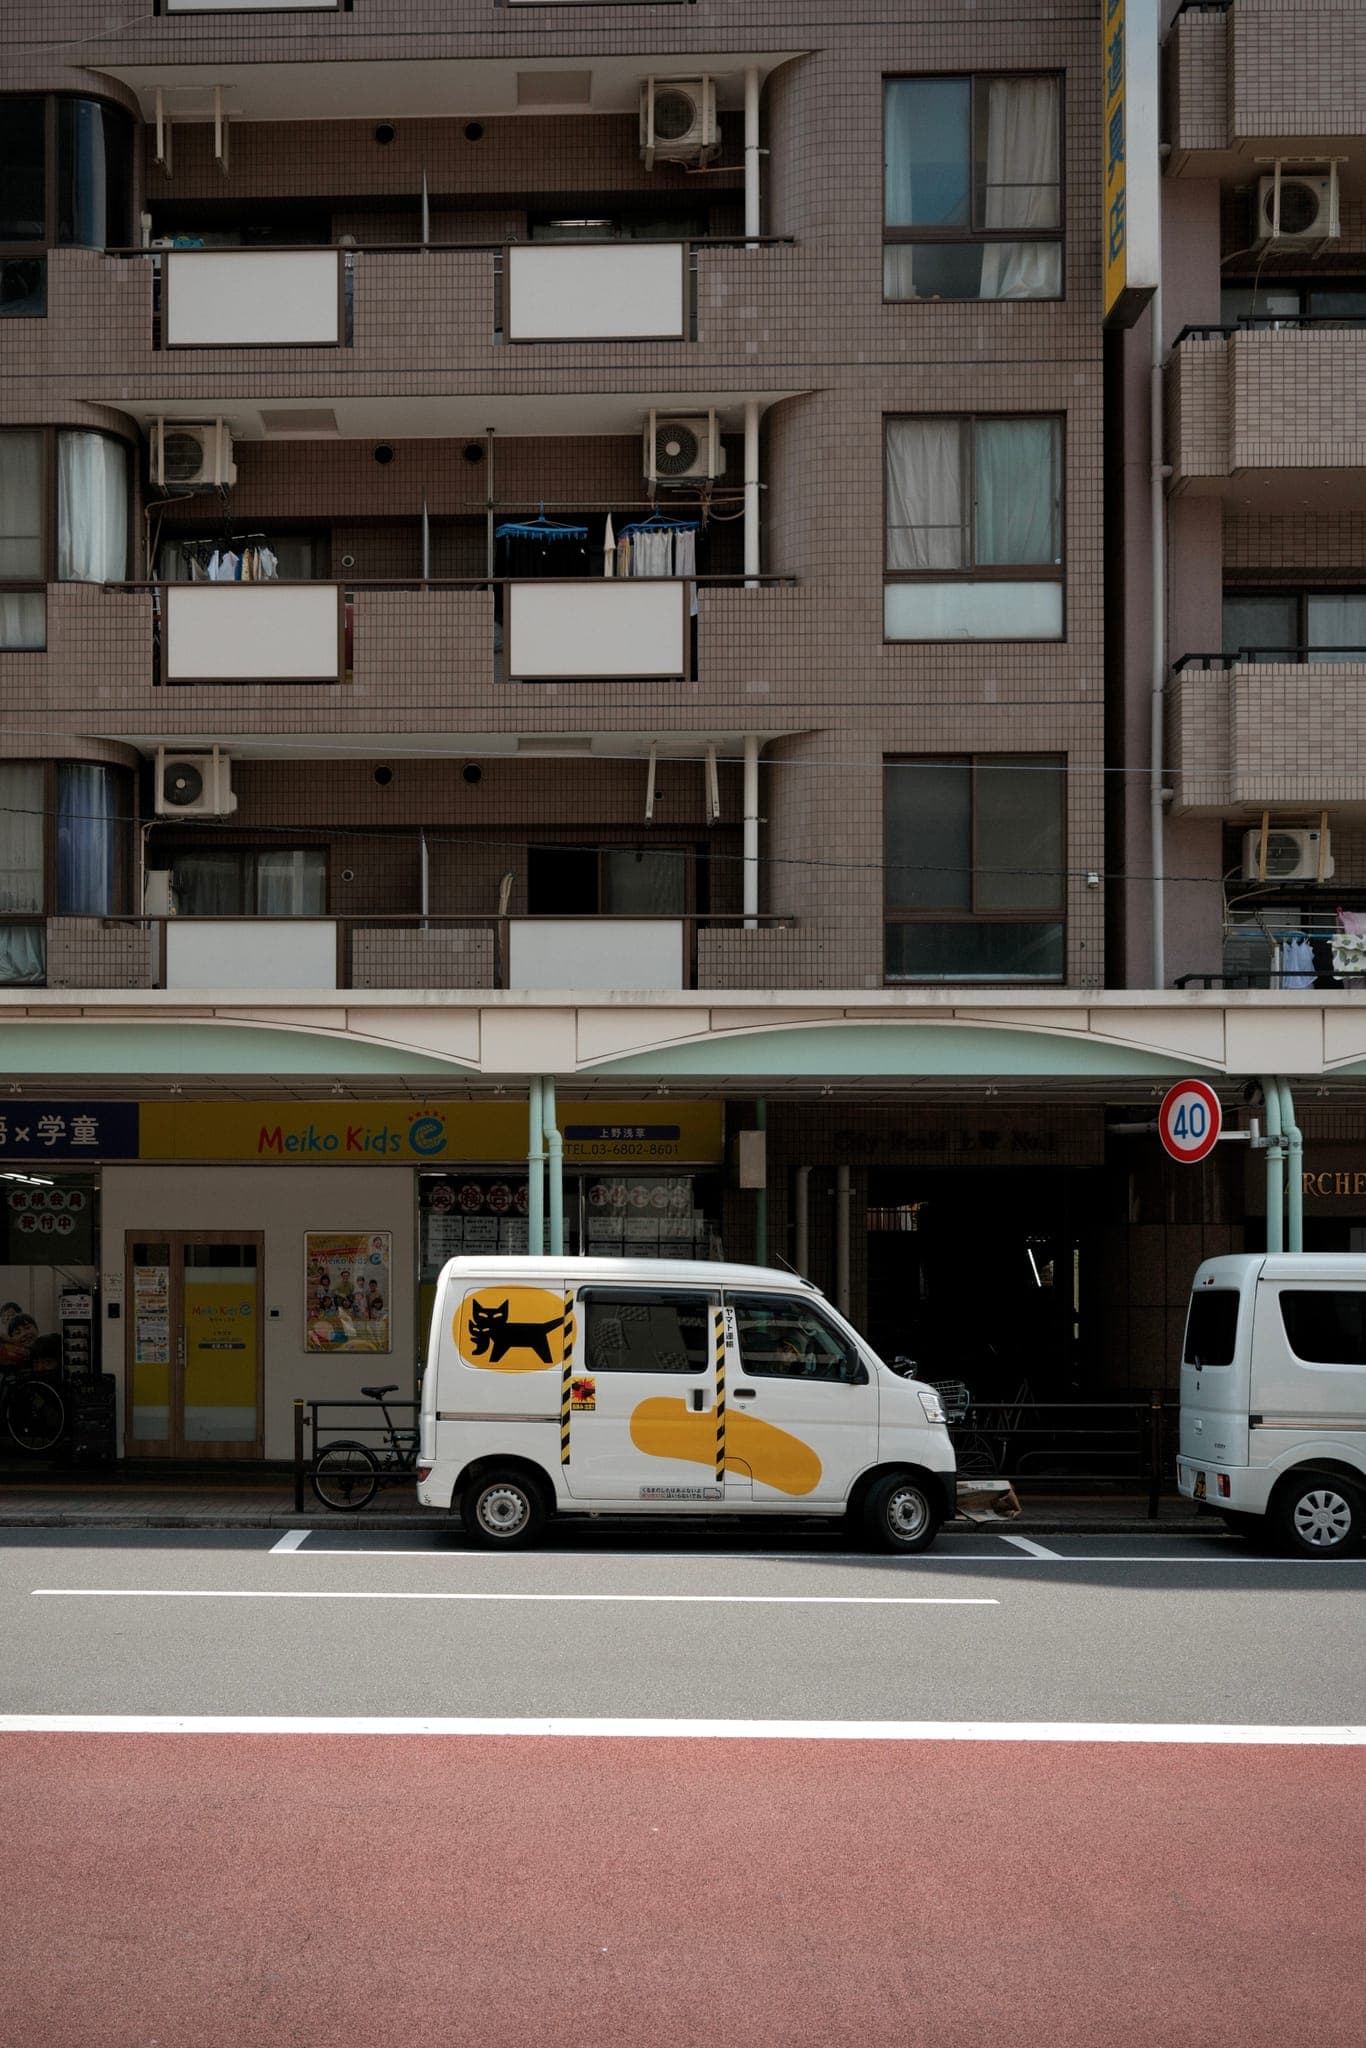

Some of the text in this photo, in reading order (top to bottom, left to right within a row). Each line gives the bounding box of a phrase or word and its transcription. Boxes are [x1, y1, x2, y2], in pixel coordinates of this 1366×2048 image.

[1107, 0, 1125, 269] 道具店
[599, 1127, 647, 1139] 上野浅草
[1173, 1103, 1205, 1139] 40
[258, 1124, 340, 1154] Meiko
[345, 1124, 402, 1156] Kids
[1283, 1171, 1366, 1197] RCHE
